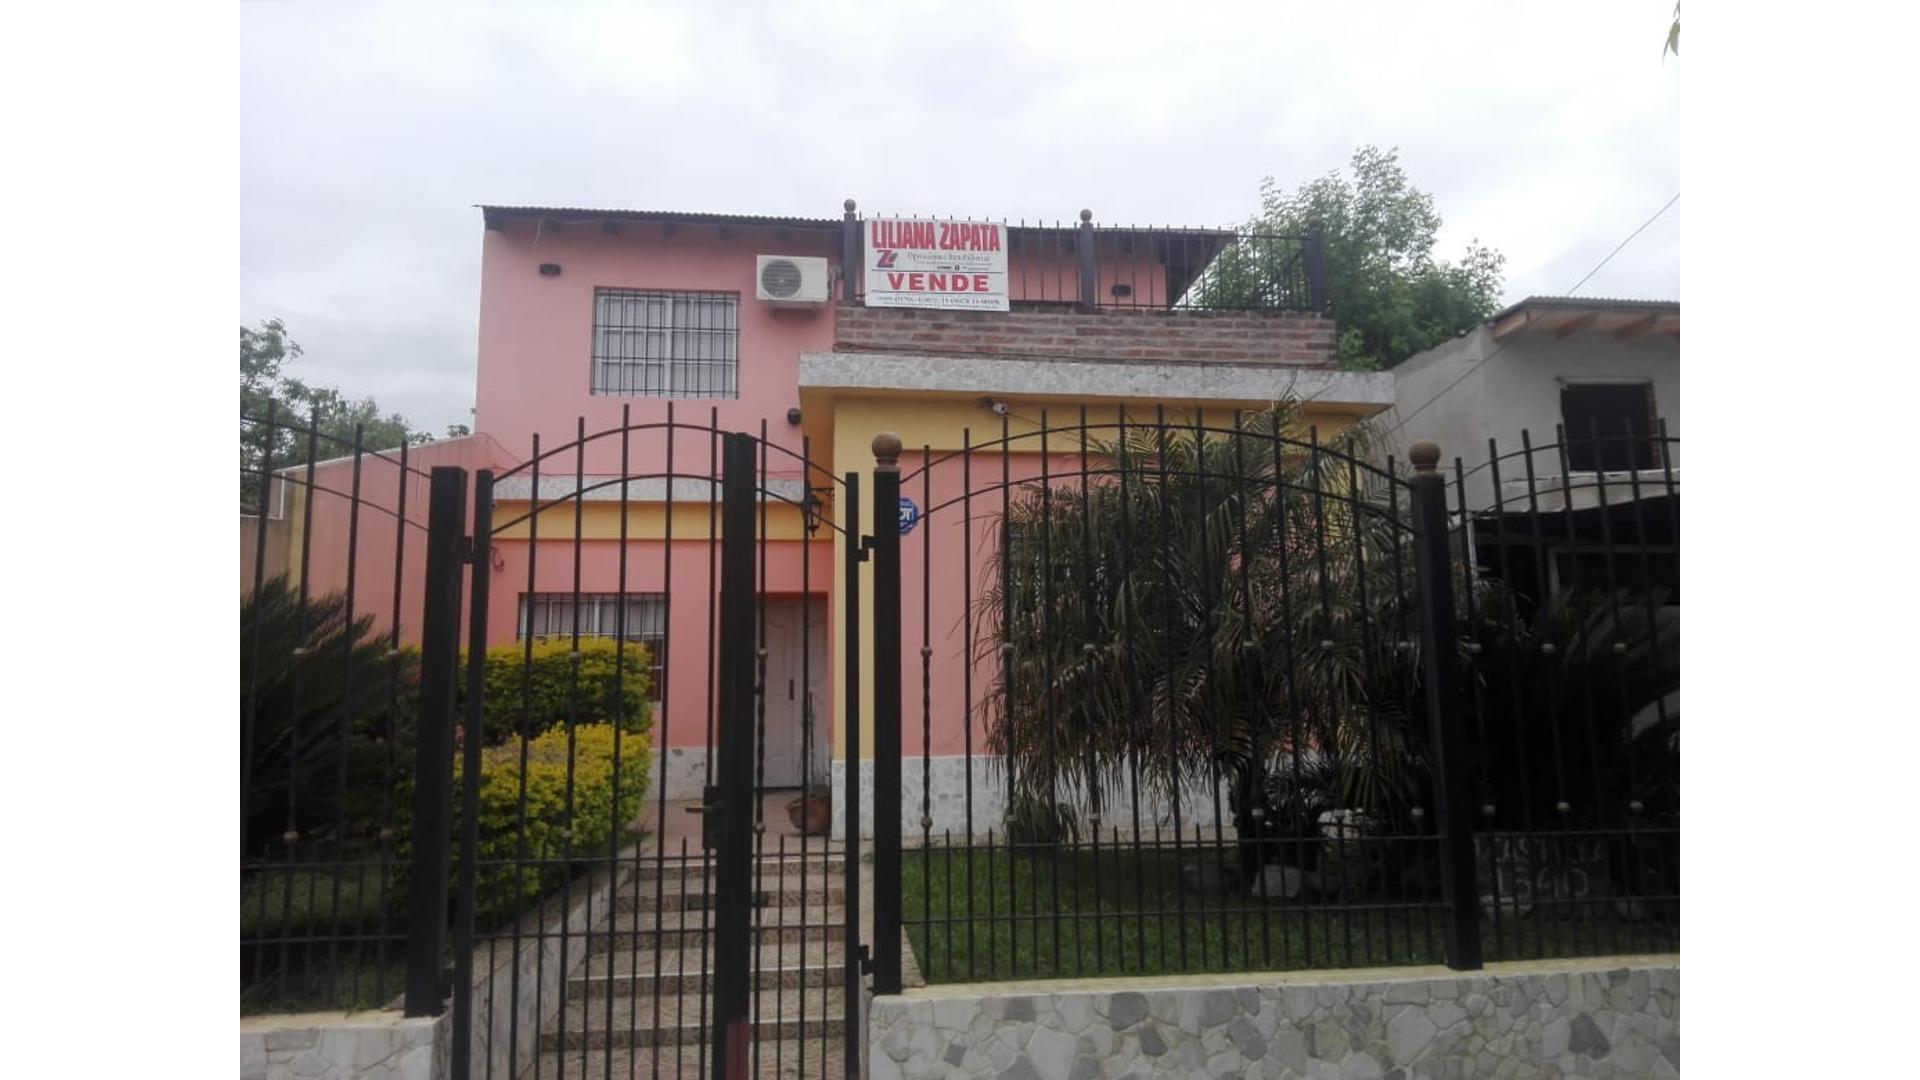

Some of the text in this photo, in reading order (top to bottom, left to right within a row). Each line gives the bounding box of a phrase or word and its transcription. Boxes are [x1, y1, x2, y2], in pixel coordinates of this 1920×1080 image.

[872, 221, 1000, 252] LILIANA ZAPATA
[887, 272, 989, 292] VENDE
